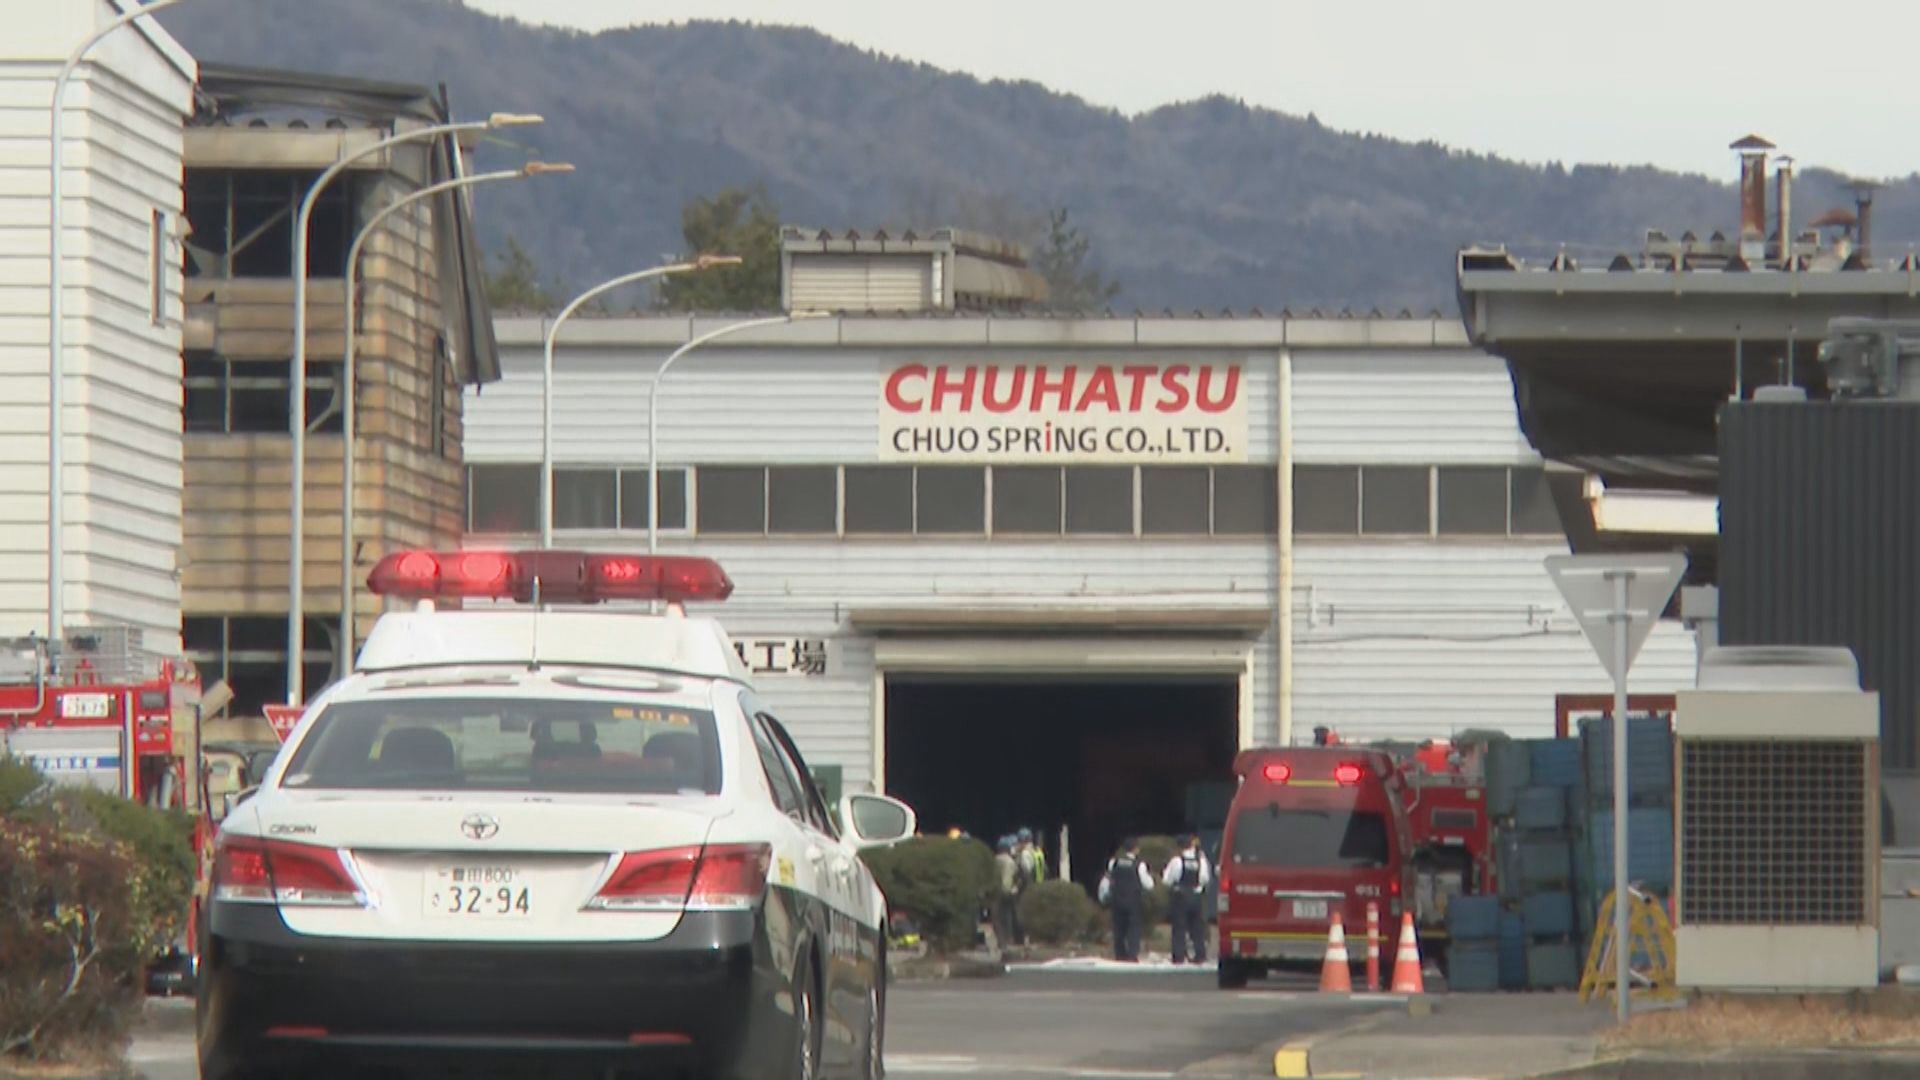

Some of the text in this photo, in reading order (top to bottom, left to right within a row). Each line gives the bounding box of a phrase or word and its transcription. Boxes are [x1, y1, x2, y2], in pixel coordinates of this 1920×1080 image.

[884, 363, 1241, 413] CHUHATSU
[893, 427, 979, 453] CHUO
[448, 886, 529, 914] 32-94
